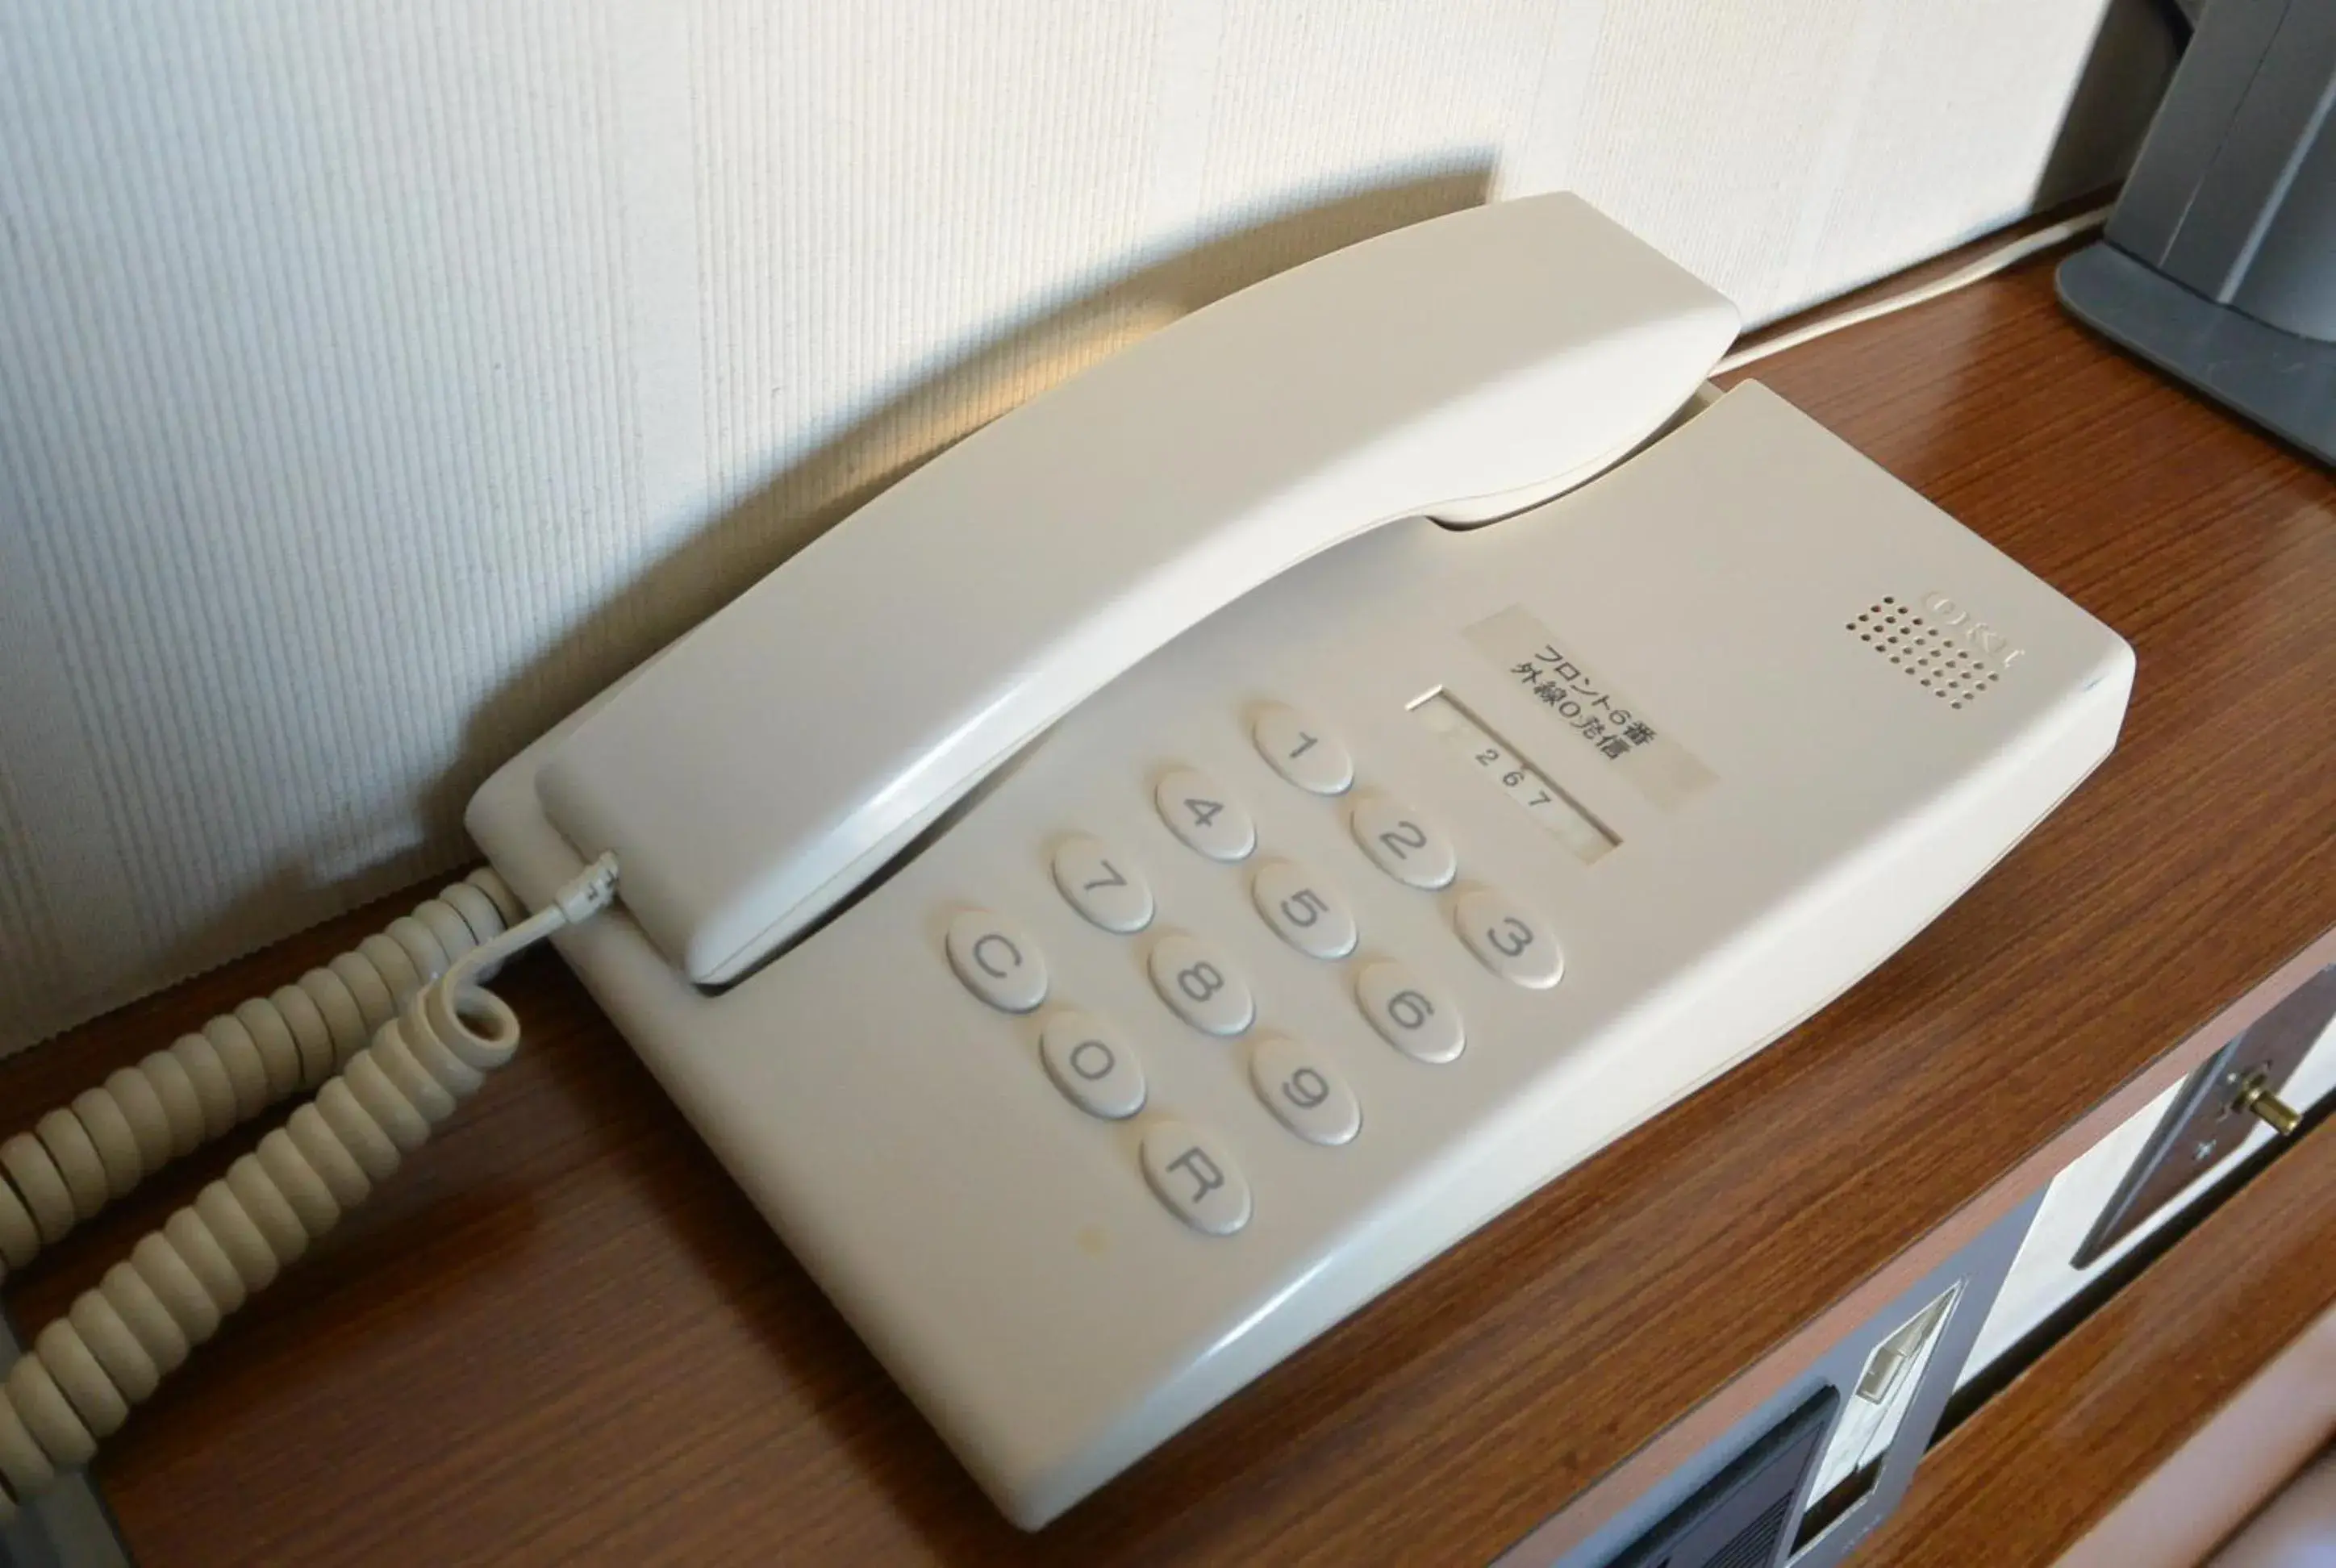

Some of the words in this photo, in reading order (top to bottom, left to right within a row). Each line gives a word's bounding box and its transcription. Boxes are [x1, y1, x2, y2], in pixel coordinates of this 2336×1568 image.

[1534, 644, 1658, 746] フロント6番
[1289, 731, 1319, 761] 1
[1183, 796, 1224, 828] 4
[1378, 819, 1428, 861] 2
[1082, 859, 1128, 894] 7
[1280, 887, 1330, 929] 5
[972, 932, 1023, 979] C
[1487, 915, 1534, 959] 3
[1177, 960, 1225, 1003] 8
[1387, 988, 1435, 1031] 6
[1281, 1066, 1331, 1108] 9
[1165, 1145, 1225, 1204] R
